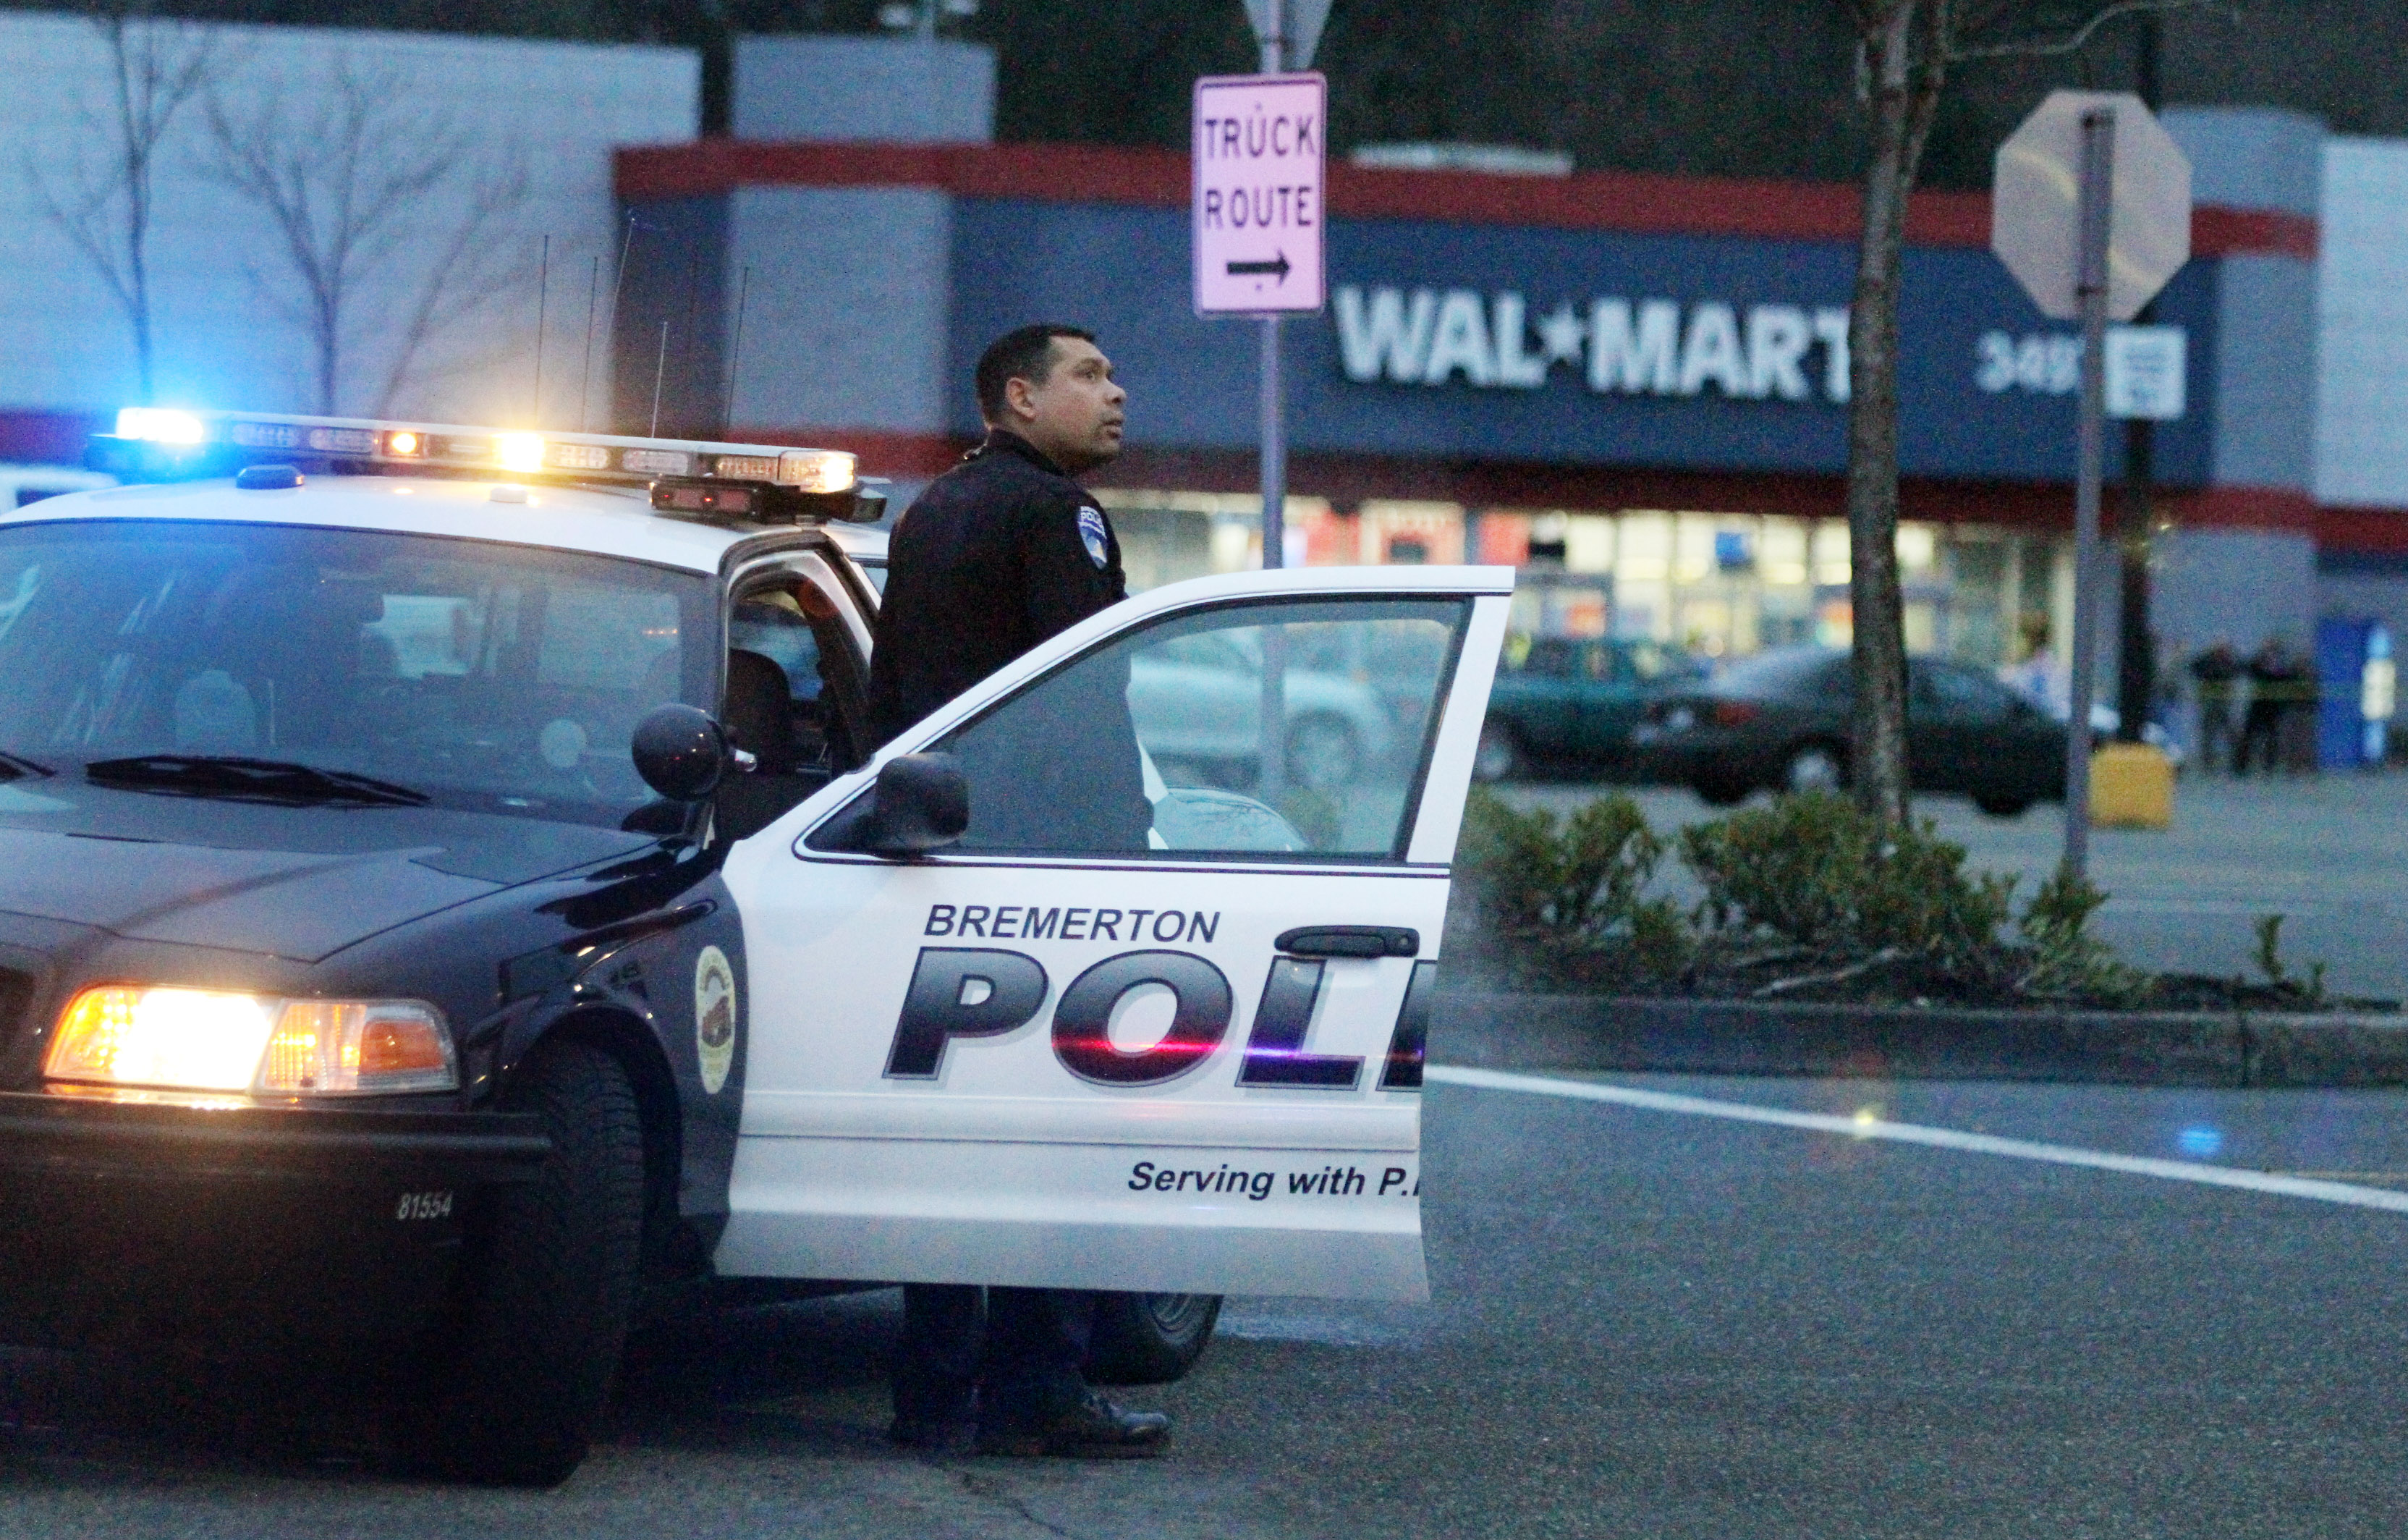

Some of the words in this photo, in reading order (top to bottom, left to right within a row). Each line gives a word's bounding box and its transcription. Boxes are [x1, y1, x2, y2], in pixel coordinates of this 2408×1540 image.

[1204, 116, 1314, 158] TRUCK
[1205, 185, 1313, 229] ROUTE
[924, 903, 1221, 943] BREMERTON
[1128, 1162, 1275, 1201] Serving
[1289, 1167, 1365, 1196] with
[1378, 1167, 1419, 1196] P.
[397, 1193, 453, 1219] 81554
